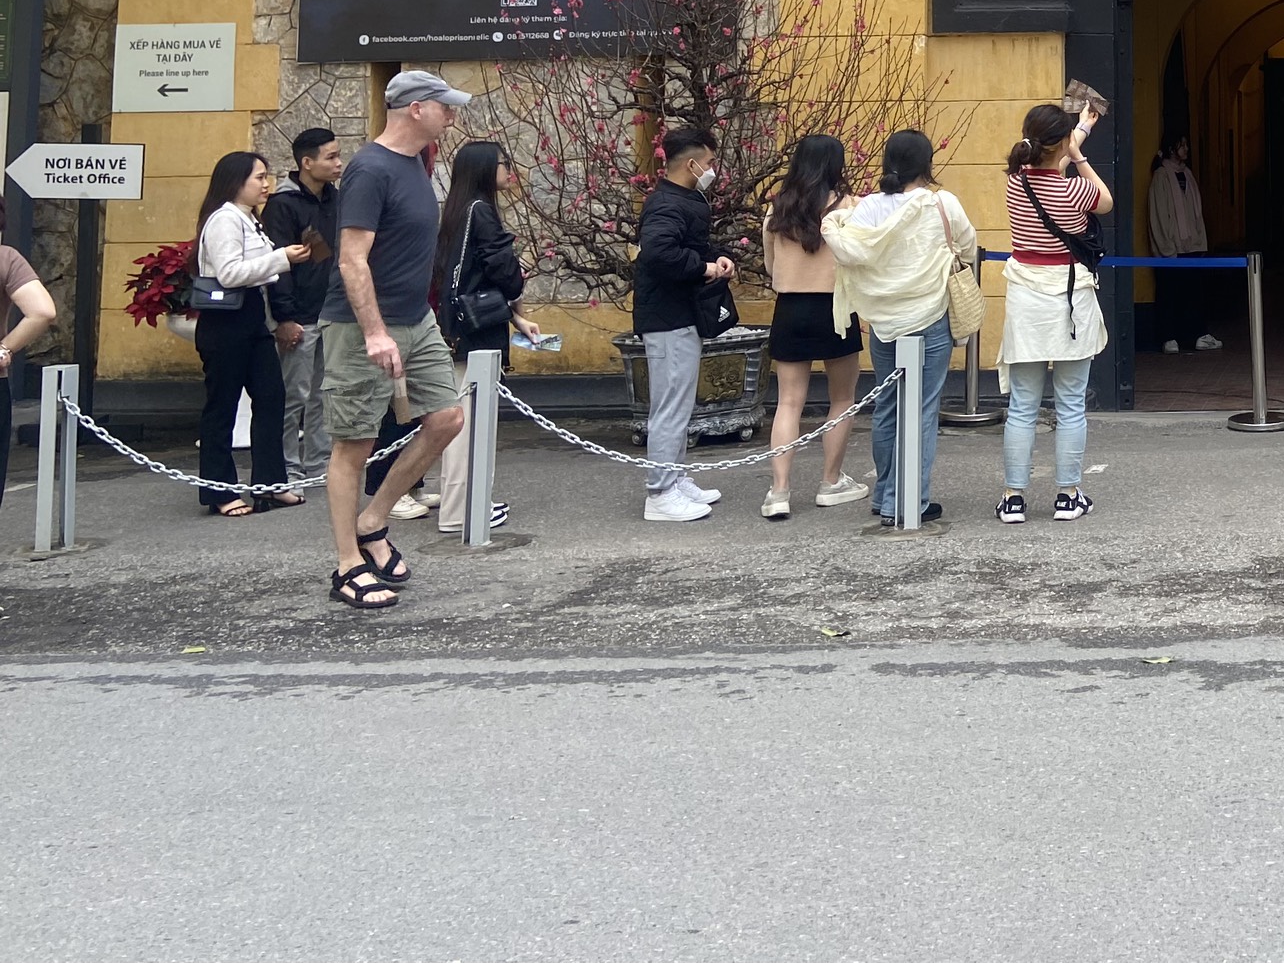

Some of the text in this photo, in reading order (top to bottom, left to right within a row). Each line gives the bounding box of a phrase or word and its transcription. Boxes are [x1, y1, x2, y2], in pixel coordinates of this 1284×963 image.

[129, 37, 221, 50] XẾP HÀNG MUA VÉ
[156, 52, 194, 64] TẠI ĐÂY
[139, 68, 209, 79] Please line up here
[44, 155, 127, 170] NƠI BÁN VÉ
[44, 172, 125, 185] Ticket Office
